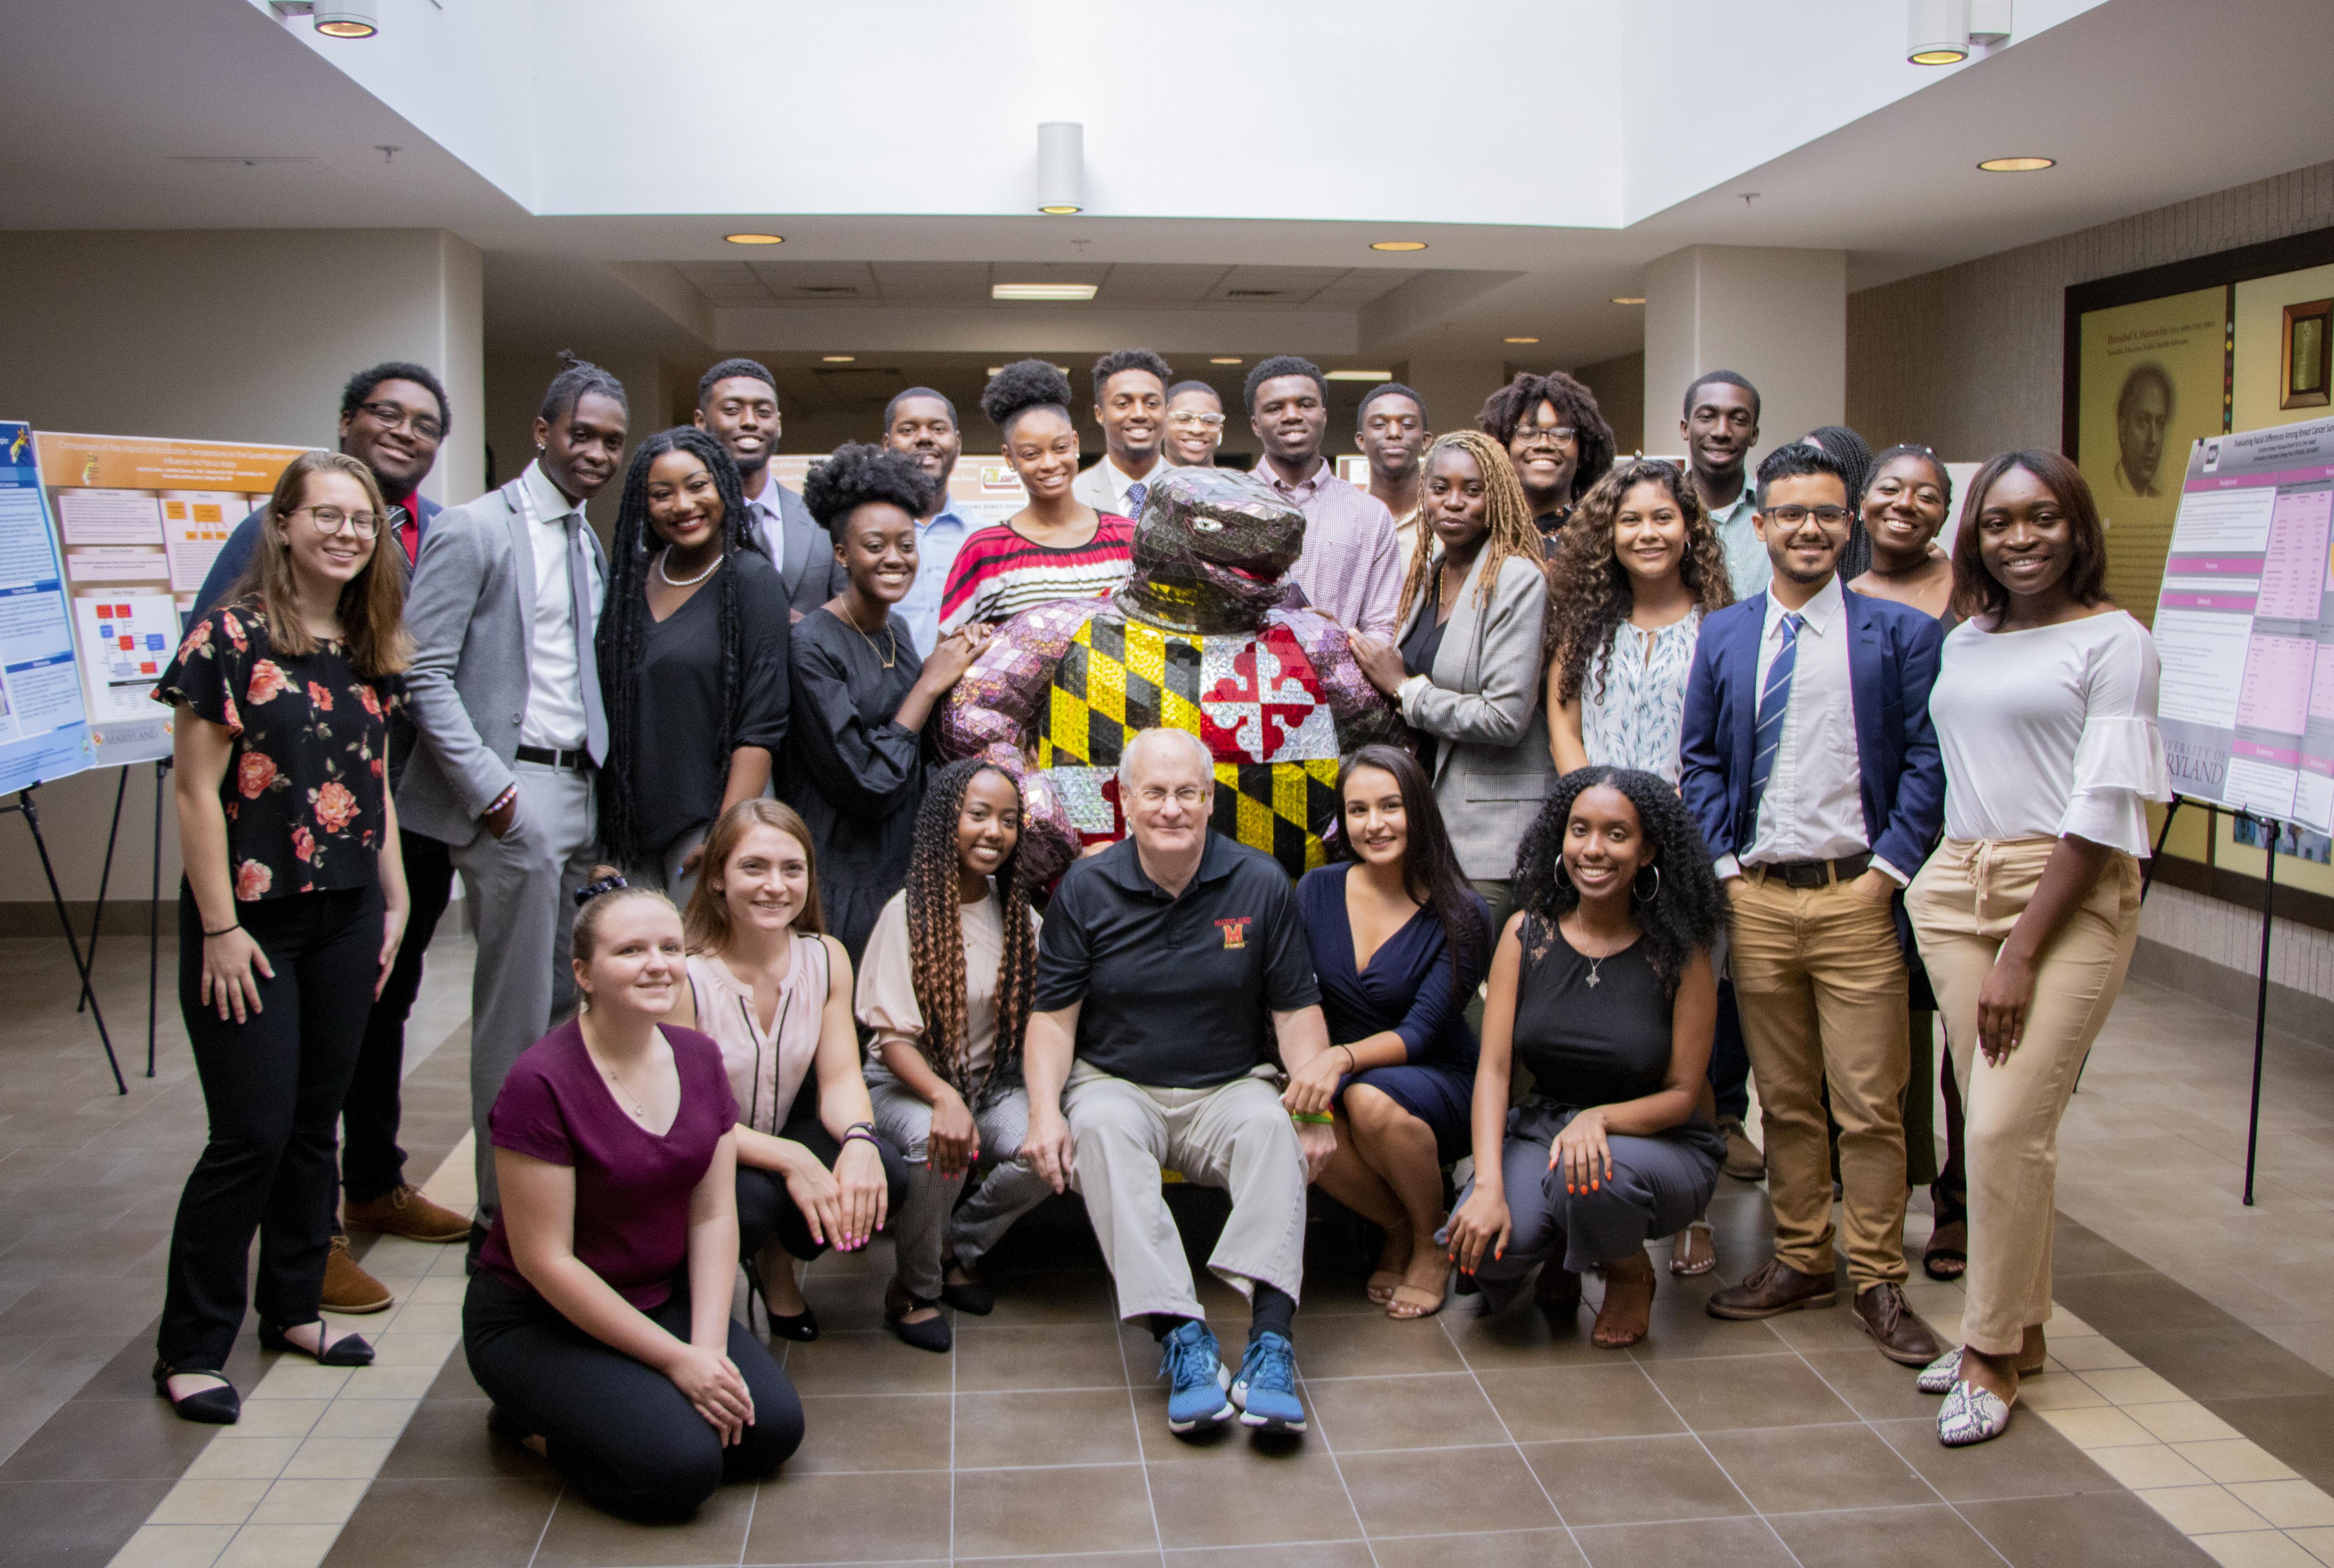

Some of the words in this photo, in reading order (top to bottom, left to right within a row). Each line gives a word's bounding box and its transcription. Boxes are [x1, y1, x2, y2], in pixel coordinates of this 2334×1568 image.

[2235, 438, 2253, 447] Evaluating
[2254, 436, 2264, 445] Racial
[2265, 433, 2284, 443] Differences
[2285, 430, 2298, 440] Among
[2299, 428, 2311, 437] Breast
[2311, 426, 2326, 435] Cancer
[2214, 750, 2227, 762] OF
[2167, 753, 2224, 785] RYLAND
[1214, 917, 1251, 926] MARYLAND
[1224, 924, 1244, 948] M
